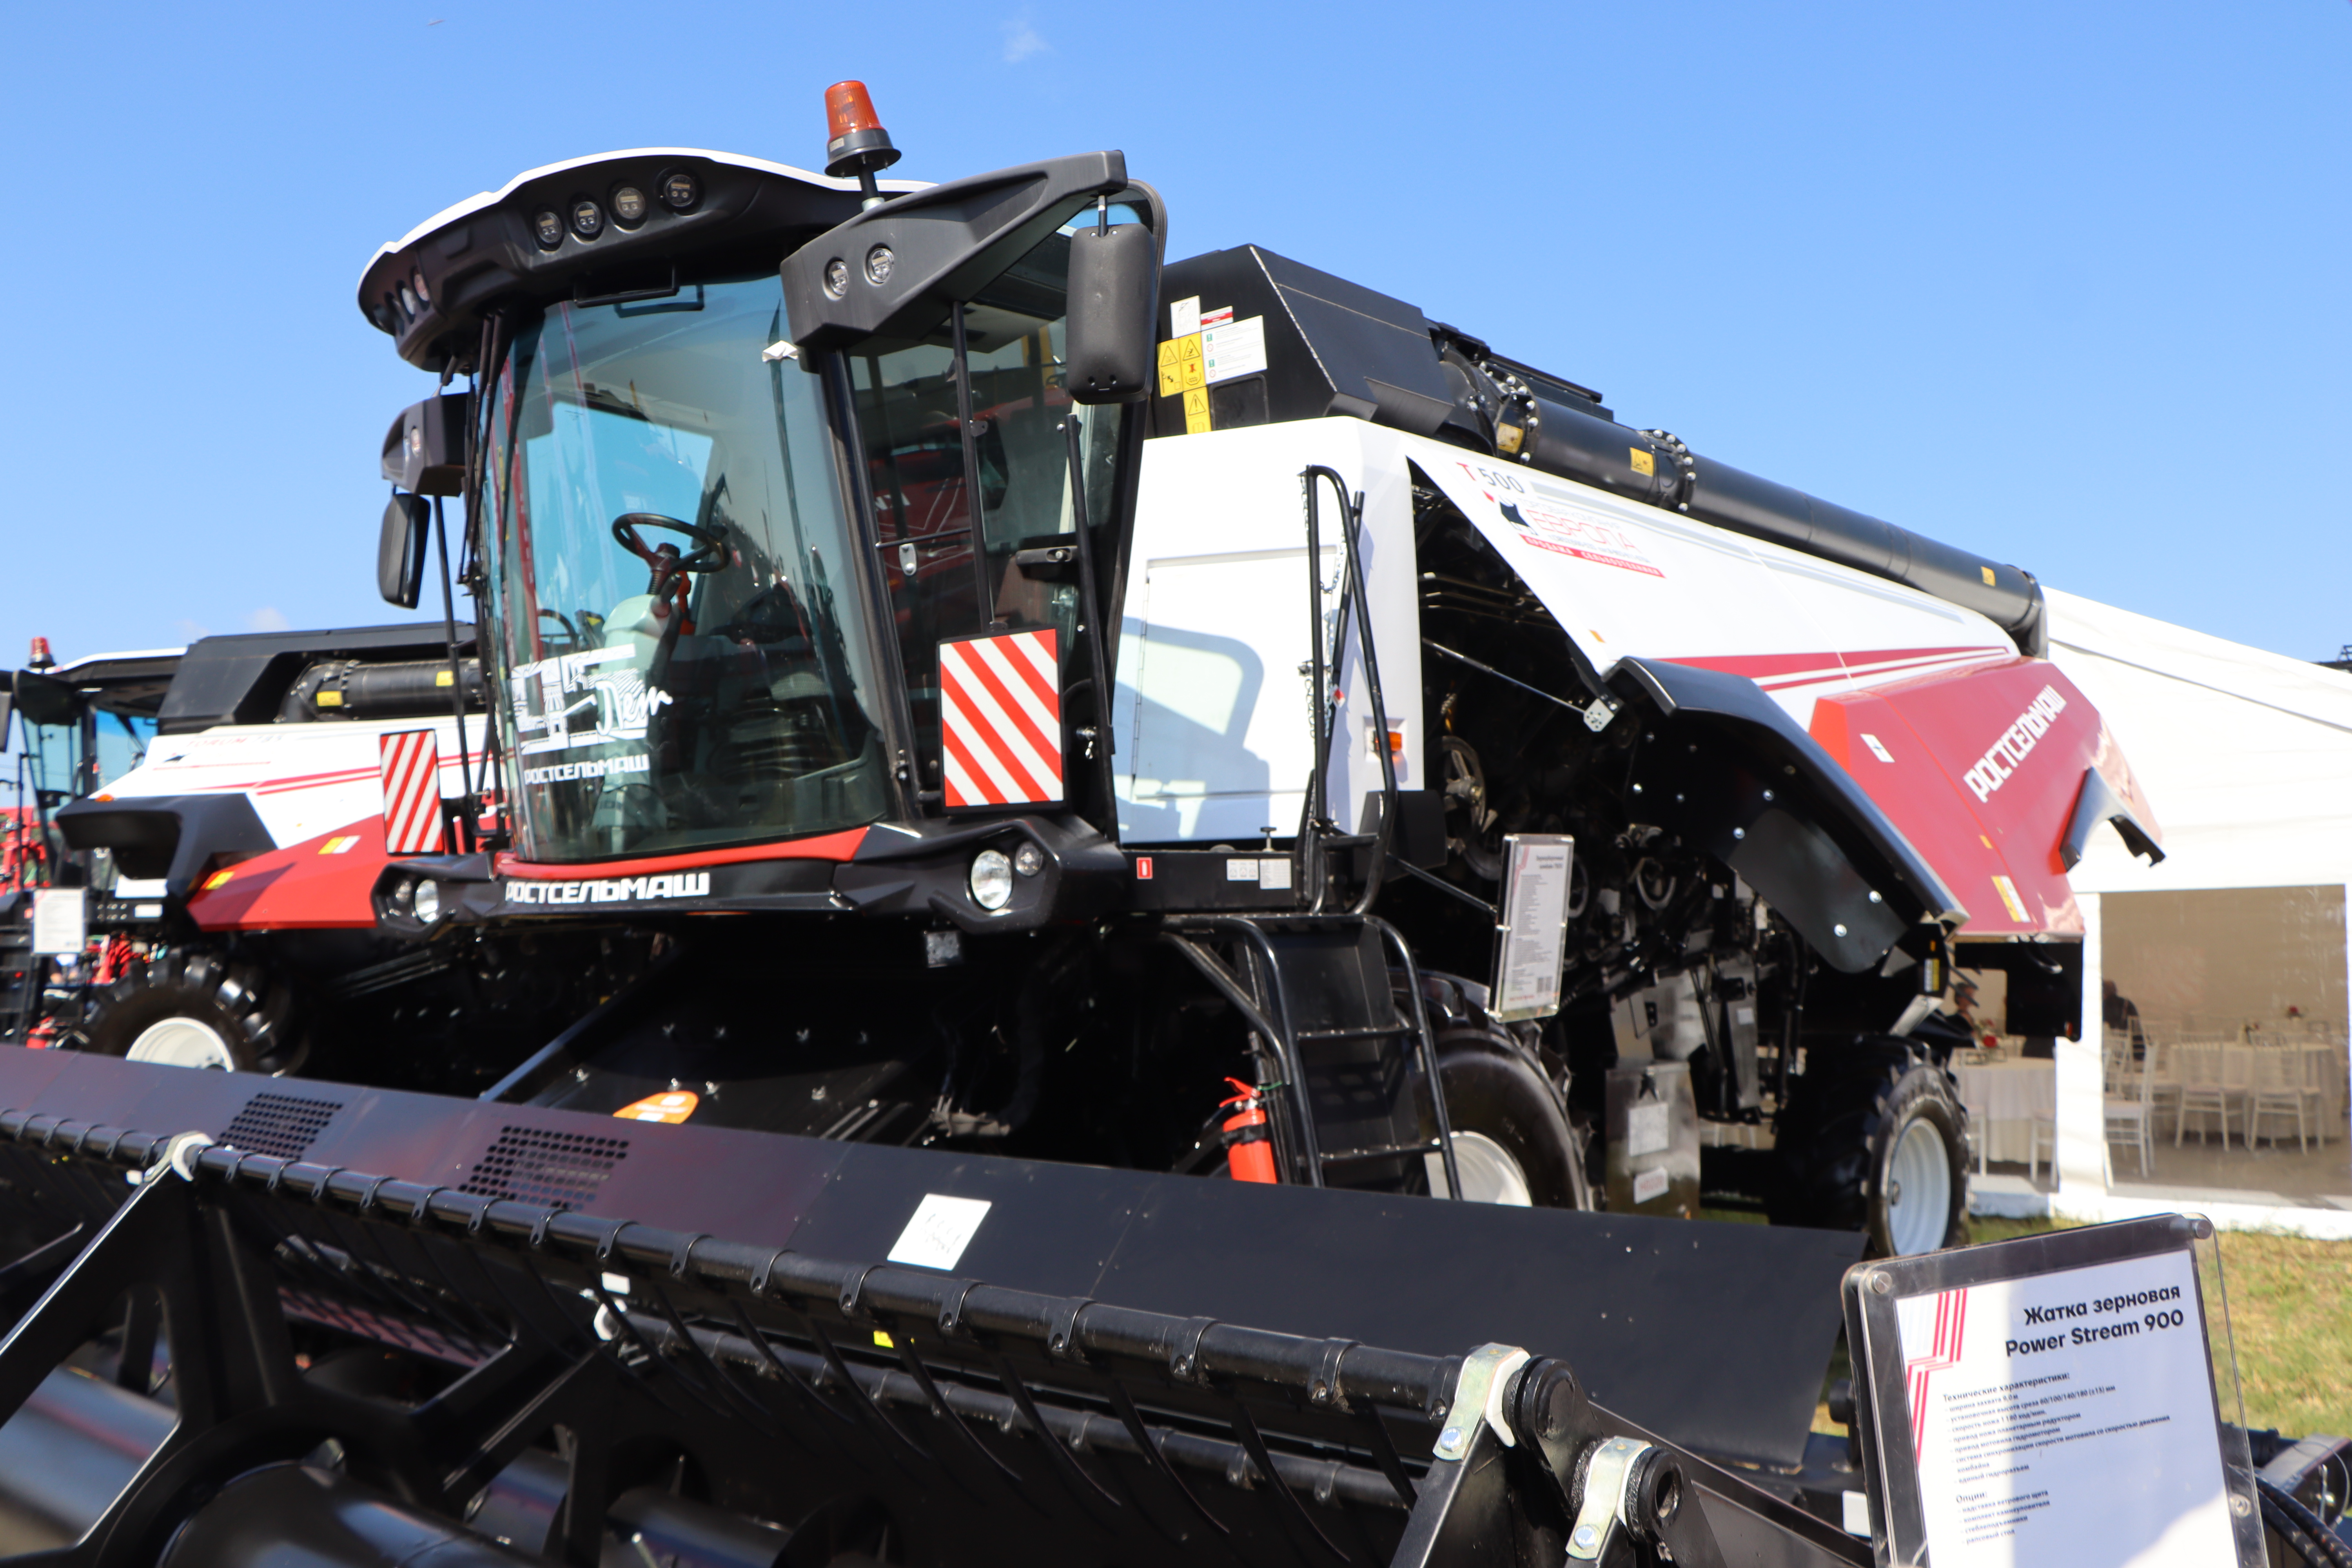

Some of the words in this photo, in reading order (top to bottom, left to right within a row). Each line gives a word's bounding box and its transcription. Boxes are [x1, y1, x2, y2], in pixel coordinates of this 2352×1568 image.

[1477, 467, 1525, 494] 500
[1526, 509, 1642, 554] ЕВРОПА
[1963, 684, 2067, 803] РОСТСЕЛЬМАШ
[524, 754, 650, 785] РОСТСЕЛЬМАШ
[505, 872, 710, 904] РОСТСЕЛЬМАШ
[2024, 1302, 2088, 1325] Жатка
[2092, 1286, 2181, 1313] зерновая
[2005, 1333, 2066, 1357] Power
[2071, 1320, 2140, 1345] Stream
[2144, 1309, 2184, 1331] 900
[1943, 1387, 1997, 1402] Технические
[2000, 1373, 2070, 1392] характеристики:
[1949, 1403, 1975, 1412] ширина
[1950, 1409, 1996, 1422] установочная
[1997, 1404, 2020, 1412] высота
[2021, 1400, 2039, 1409] среза
[1952, 1423, 1982, 1433] скорость
[1953, 1433, 1978, 1443] привод
[1997, 1421, 2042, 1435] планетарным
[2042, 1413, 2081, 1426] редуктором
[1955, 1444, 1980, 1453] привод
[1981, 1437, 2012, 1446] мотовила
[2013, 1428, 2061, 1442] гидромотором
[1956, 1454, 1982, 1462] система
[1984, 1443, 2034, 1457] синхронизации
[2035, 1437, 2064, 1447] скорости
[2065, 1430, 2095, 1441] мотовила
[2105, 1422, 2138, 1434] скоростью
[2138, 1415, 2170, 1427] движения
[1957, 1462, 1989, 1472] комбайна
[1956, 1491, 1987, 1504] Опции:
[1997, 1494, 2031, 1506] ветрового
[2031, 1490, 2049, 1500] щита
[1964, 1513, 1995, 1523] комплект
[1966, 1533, 1999, 1544] рапсовый
[2000, 1529, 2015, 1537] стол
